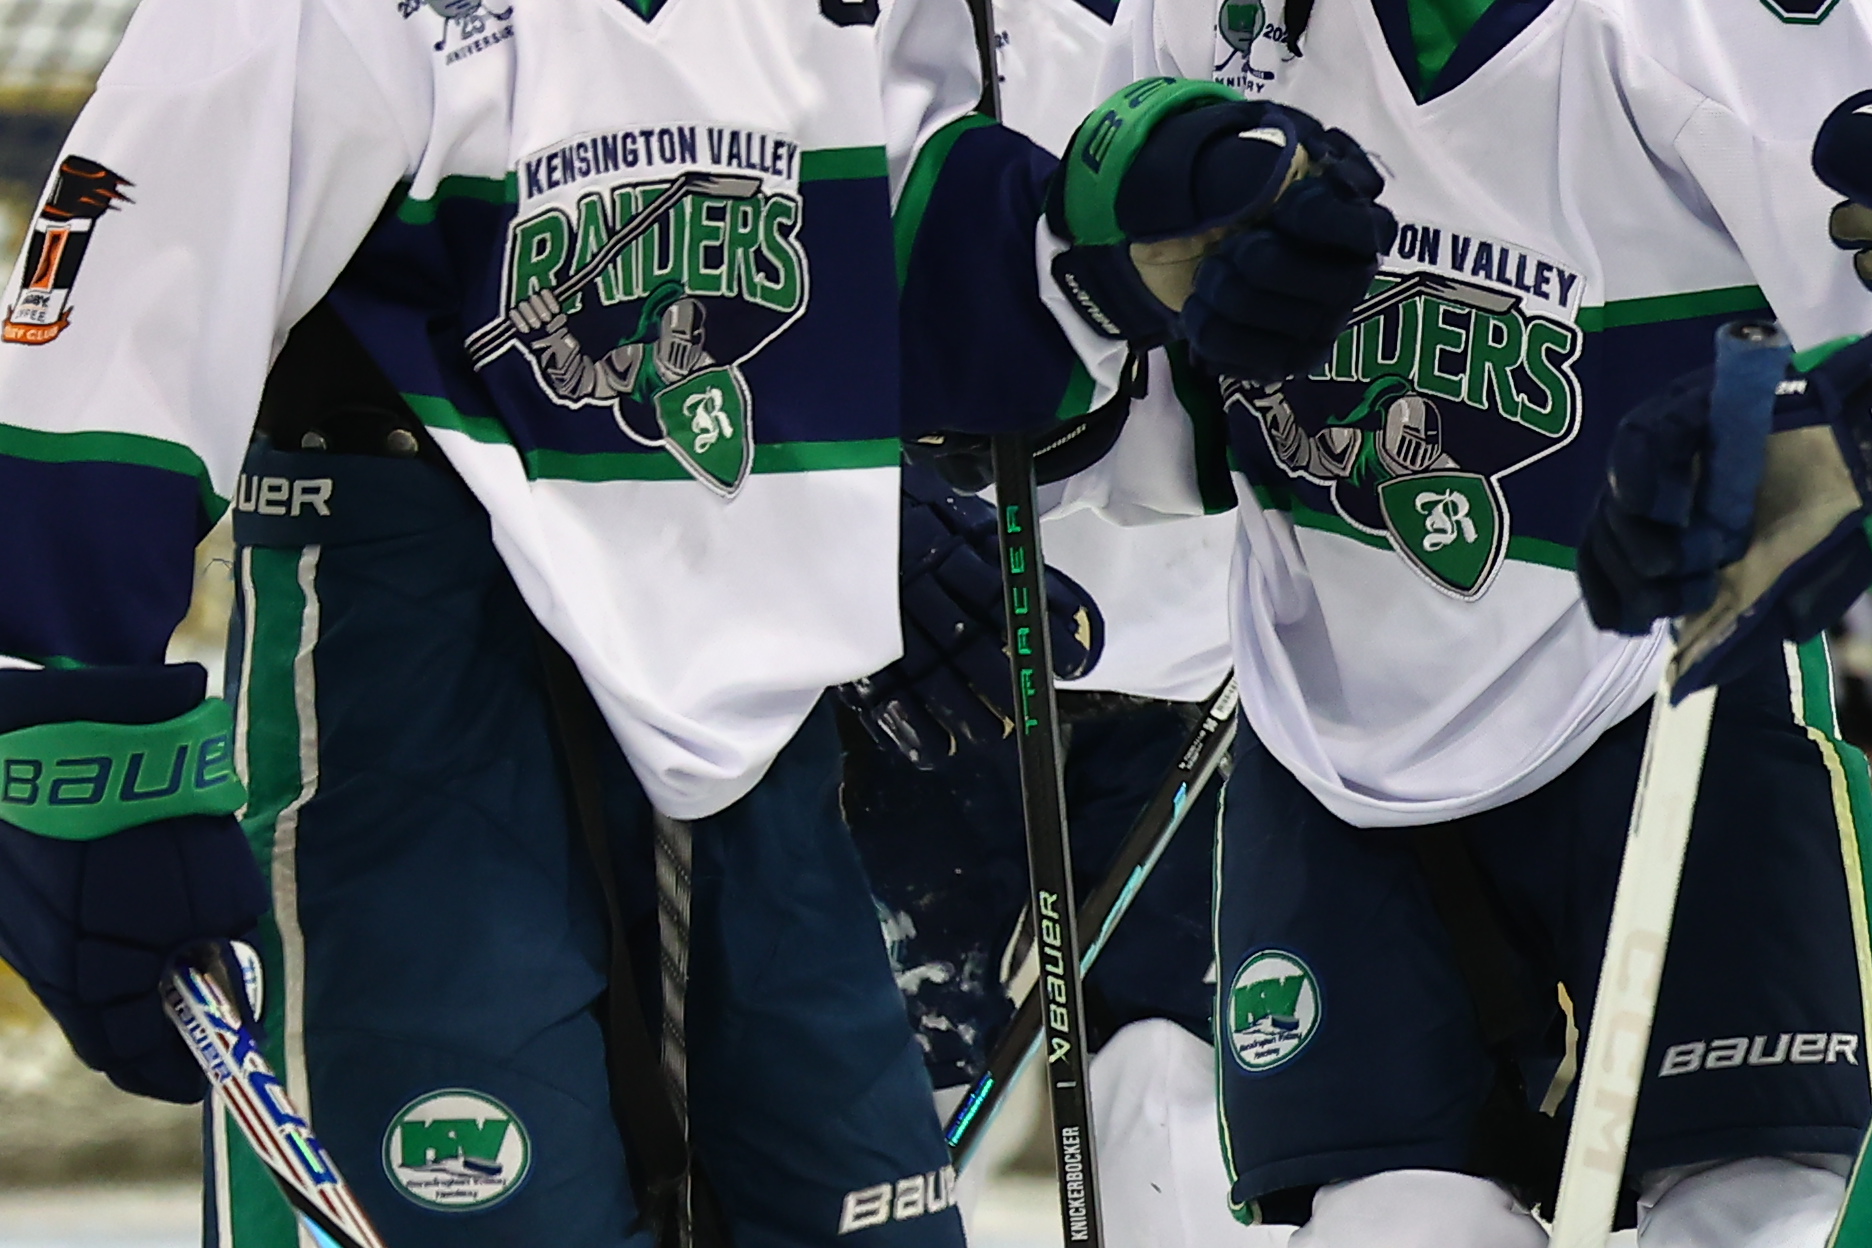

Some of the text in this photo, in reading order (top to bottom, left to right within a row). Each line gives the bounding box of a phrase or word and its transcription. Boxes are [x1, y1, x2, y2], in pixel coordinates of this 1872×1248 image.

[525, 125, 801, 200] KENSINGTON VALLEY
[511, 182, 803, 314] RAIDERS
[1449, 233, 1578, 309] VALLEY
[1308, 276, 1573, 439] IDERS
[238, 472, 334, 517] UER
[1, 734, 238, 808] BAUE
[1658, 1031, 1860, 1079] BAUER
[838, 1164, 958, 1235] BAU
[1063, 1125, 1089, 1242] KNICKERBOCKER
